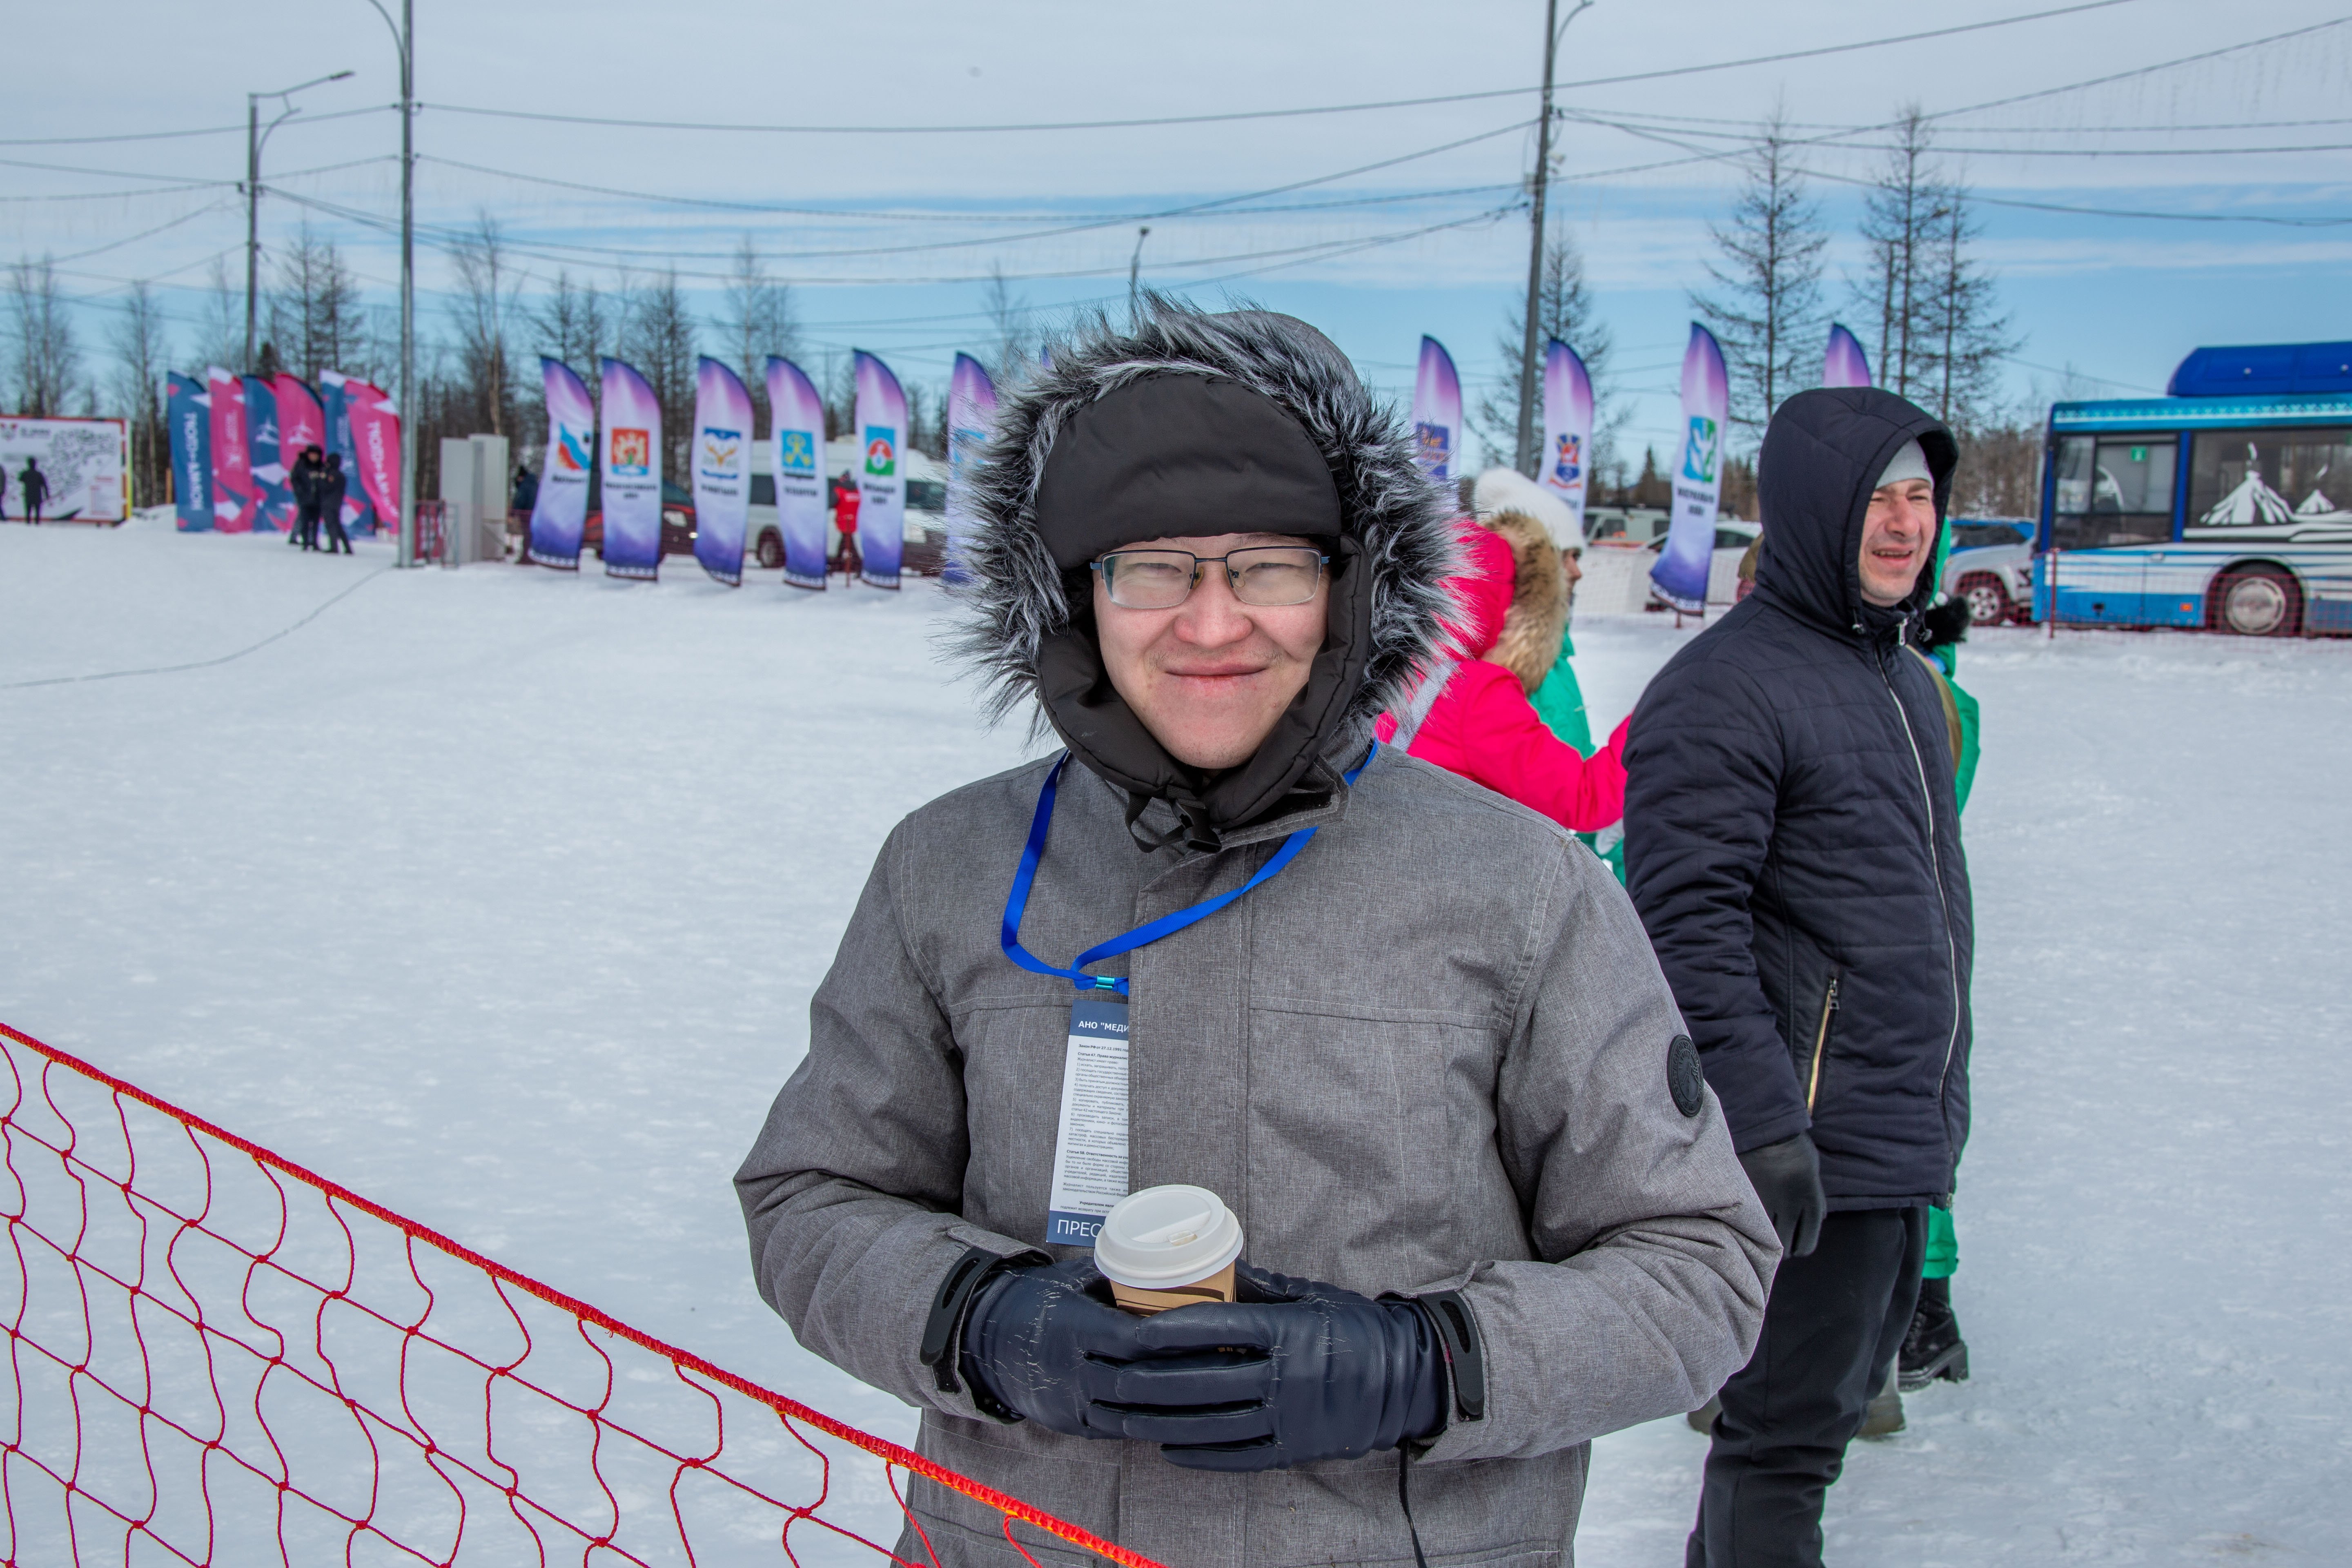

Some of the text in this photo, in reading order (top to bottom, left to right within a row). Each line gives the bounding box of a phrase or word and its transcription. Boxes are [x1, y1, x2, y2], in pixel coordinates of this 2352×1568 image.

[1078, 1020, 1129, 1033] АНО "МЕДИ
[1057, 1219, 1102, 1238] ПРЕС
